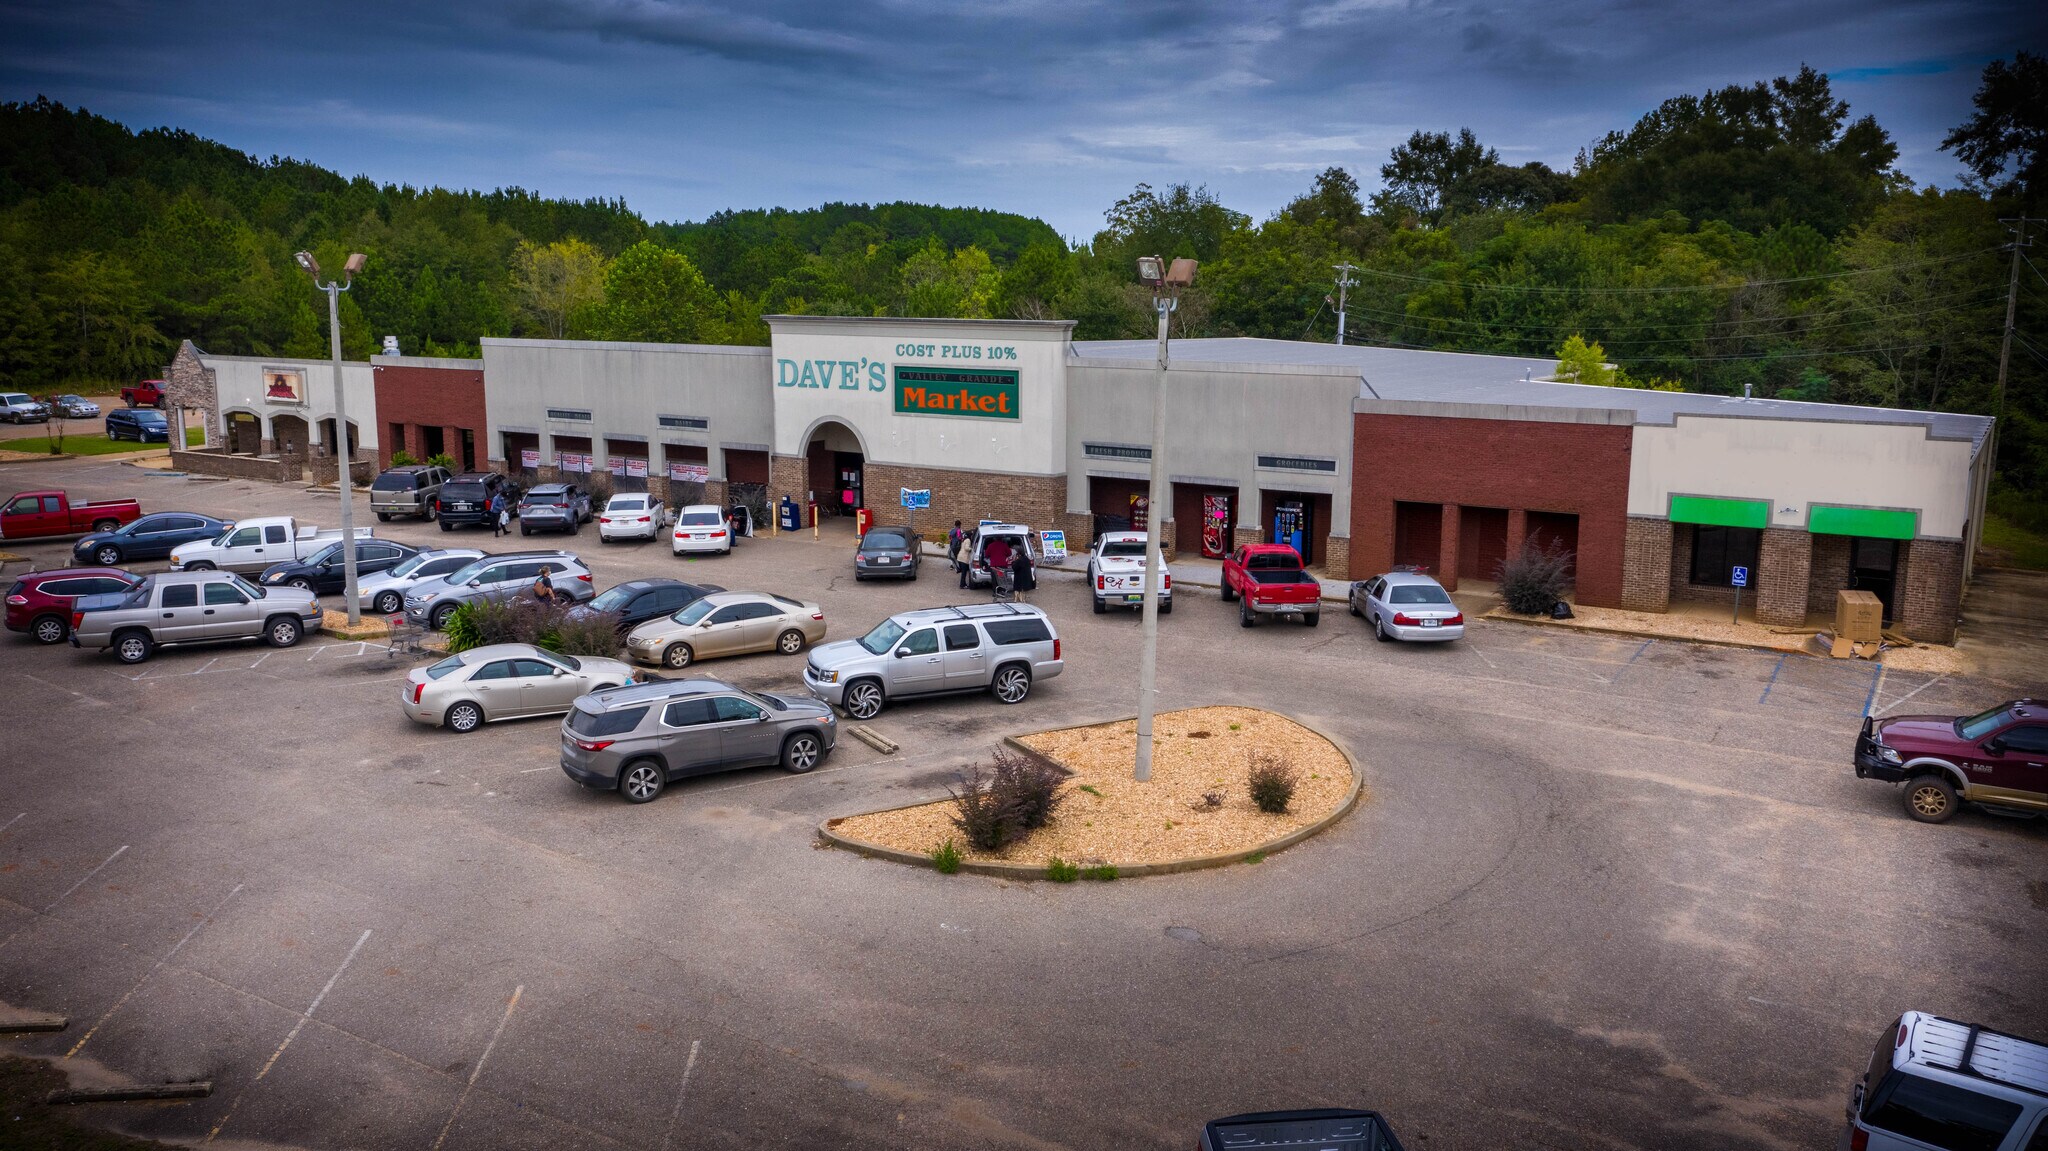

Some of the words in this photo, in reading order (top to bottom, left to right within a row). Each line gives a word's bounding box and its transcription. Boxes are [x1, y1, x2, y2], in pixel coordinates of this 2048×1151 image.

[896, 344, 936, 358] COST
[942, 345, 982, 360] PLUS
[988, 346, 1018, 361] 10%
[777, 357, 887, 393] DAVE'S
[908, 372, 948, 381] VALLEY
[959, 374, 1005, 384] GRANDE
[903, 387, 1011, 413] Market
[1090, 447, 1112, 455] FRESH
[1117, 449, 1150, 458] PRODUCE
[1276, 459, 1319, 469] GROCERIES
